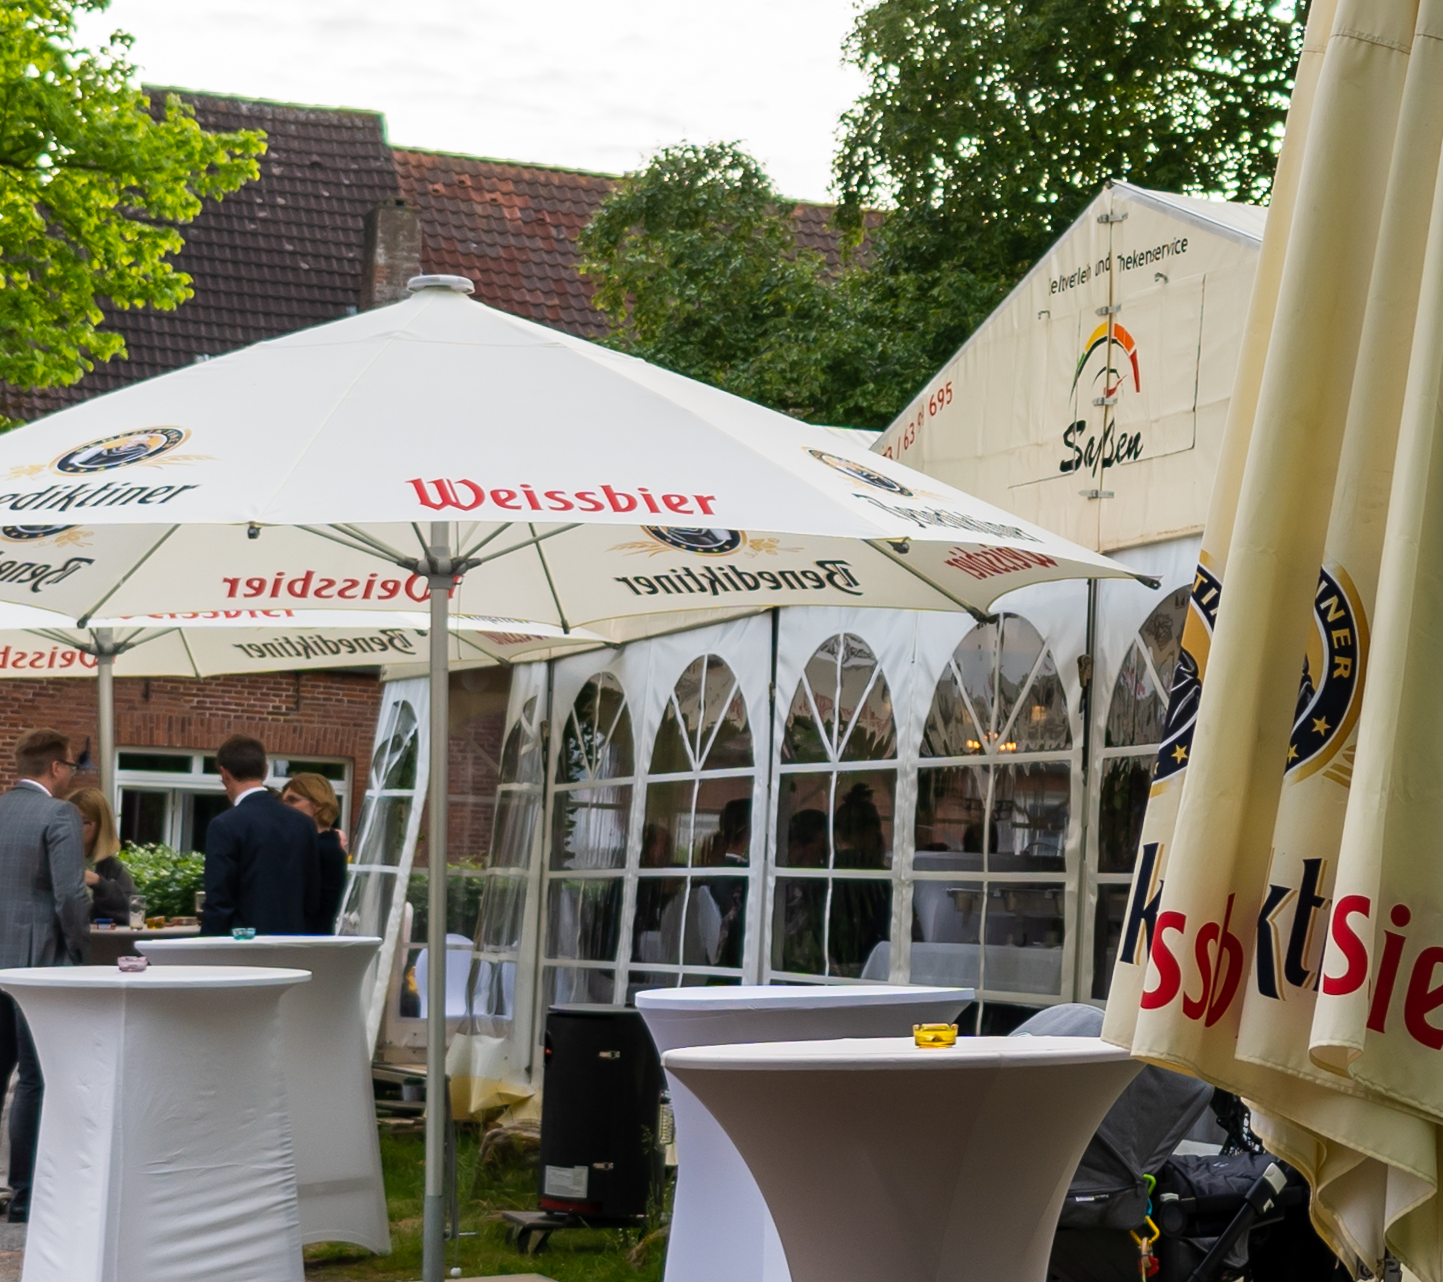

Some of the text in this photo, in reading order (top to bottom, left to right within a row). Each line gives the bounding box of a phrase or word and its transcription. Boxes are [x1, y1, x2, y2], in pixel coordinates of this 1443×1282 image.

[1095, 252, 1111, 277] und
[929, 381, 953, 417] 695
[1059, 416, 1144, 478] Saßen
[404, 477, 718, 517] Weissbier
